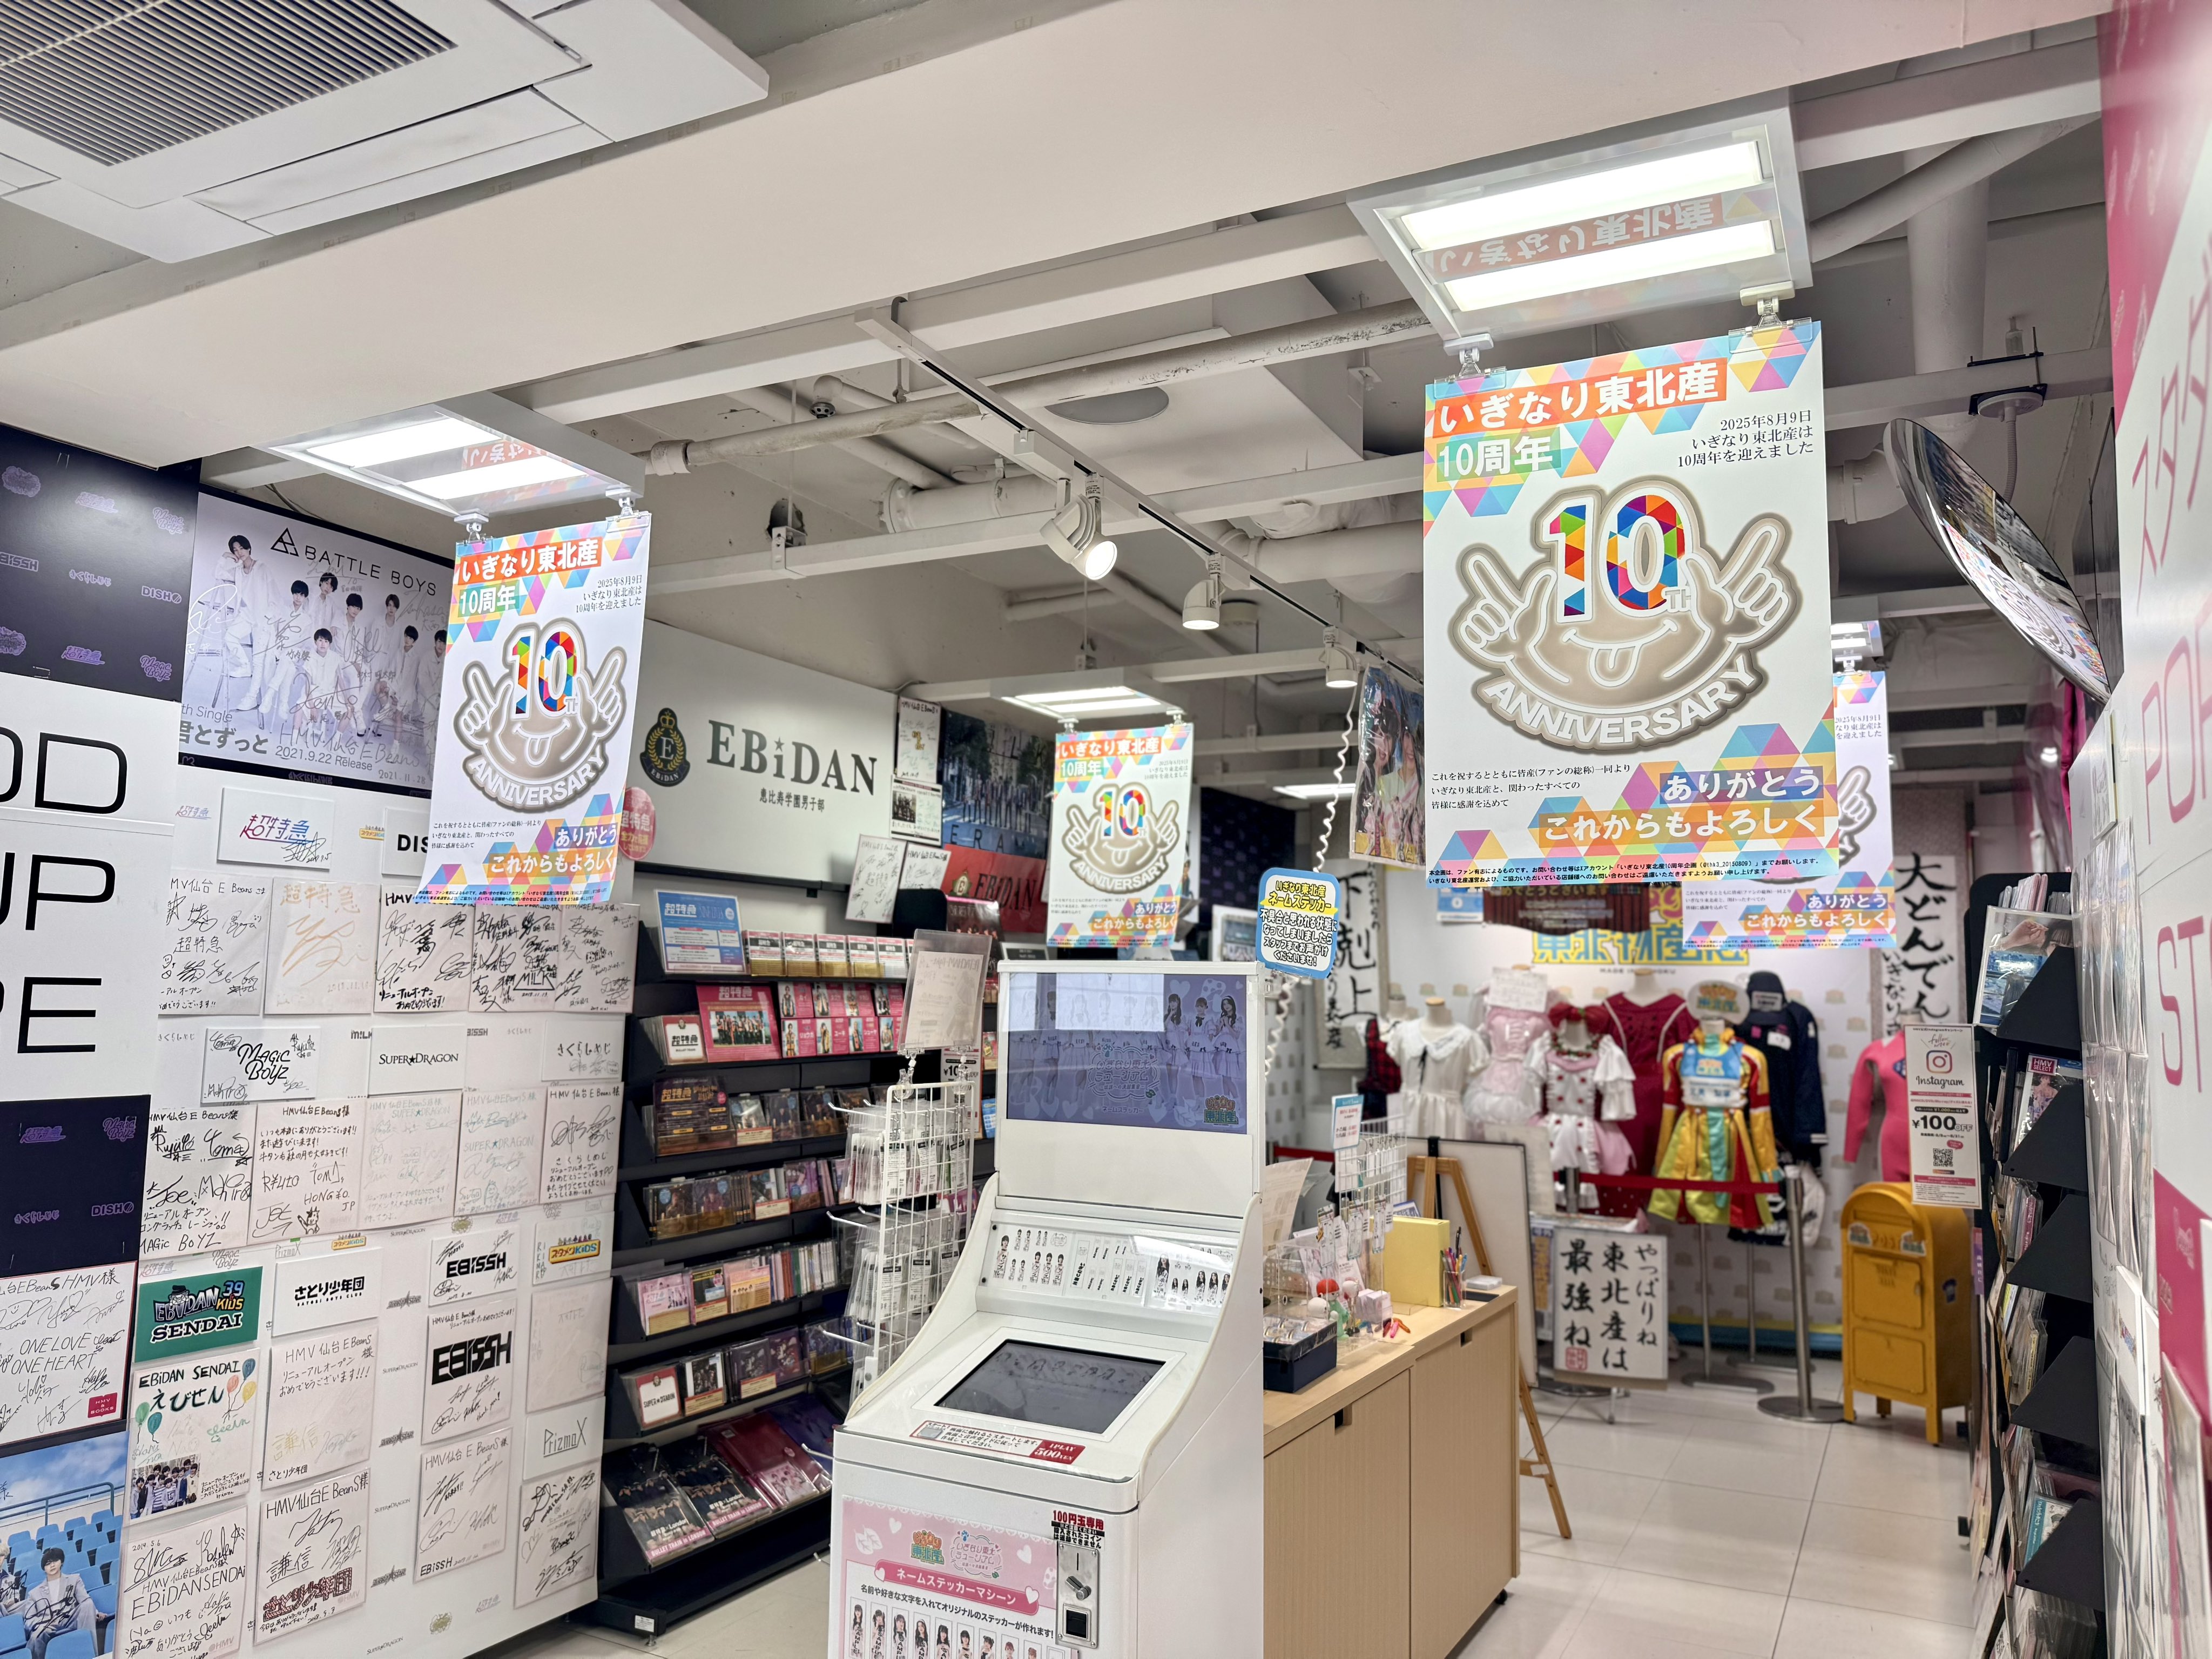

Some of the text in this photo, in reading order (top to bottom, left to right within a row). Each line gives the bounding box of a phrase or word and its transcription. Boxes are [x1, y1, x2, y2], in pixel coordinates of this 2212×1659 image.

[1440, 362, 1718, 433] いぎなり東北産
[1720, 409, 1812, 431] 2025年8月9日
[1692, 425, 1813, 450] いぎなり東北産は
[1439, 436, 1553, 478] 10周年
[1677, 441, 1814, 468] 10周年を迎えました
[305, 545, 436, 596] BATTLE BOYS
[462, 538, 598, 582] いぎなり東北産
[598, 575, 642, 588] 2025年8月9日
[460, 586, 516, 615] 10周年
[583, 586, 642, 600] いぎなり東北産は
[576, 597, 642, 613] 10周年を迎えました
[1485, 655, 1754, 744] ANNIVERSARY
[196, 705, 233, 724] Single
[179, 720, 268, 755] 君とずっと
[1062, 738, 1159, 757] いぎなり東北産
[275, 746, 373, 771] 2021.9.22 Release
[706, 719, 878, 795] EBiDAN
[470, 746, 604, 806] ANNIVERSARY
[1062, 761, 1102, 776] 10周年
[1432, 781, 1580, 795] いぎなり東北産と、関わったすべての
[1664, 769, 1820, 801] ありがとう
[760, 787, 825, 812] 恵比寿学園男子部
[1432, 799, 1509, 810] 皆様に感謝を込めて
[176, 805, 211, 819] 超特急
[1546, 804, 1816, 840] これからもよろしく
[240, 814, 313, 843] 超特急
[556, 826, 617, 847] ありがとう
[491, 852, 616, 874] これからもよろしく
[1077, 855, 1166, 891] ANNIVERSARY
[1276, 881, 1326, 897] いぎなり東北産
[664, 902, 697, 918] 超特急
[1136, 903, 1176, 914] ありがとう
[1269, 891, 1331, 912] ネームステッカー
[1809, 895, 1886, 909] ありがとう
[1094, 918, 1175, 929] これからもよろしく
[1260, 908, 1338, 932] 不具合と思われる状態に
[1748, 913, 1885, 928] これからもよろしく
[173, 936, 223, 954] 超特急
[1263, 923, 1333, 945] なってしまいましたら
[1894, 852, 1957, 1018] 大どんでん
[1264, 936, 1328, 957] スタッフまでお声がけ
[1273, 950, 1317, 967] くださいませ!
[718, 986, 752, 1000] 超特急
[558, 1042, 610, 1057] さくらしめじ
[672, 1034, 698, 1047] 超特急
[1916, 1076, 1964, 1089] Instagram
[661, 1087, 692, 1102] 超特急
[1102, 1106, 1143, 1114] ネームステッカー
[1204, 1110, 1238, 1124] 東北産
[1912, 1115, 1973, 1132] ¥100 OFF
[295, 1277, 365, 1300] さとり少年団
[1561, 1238, 1594, 1348] 最強ね
[1601, 1242, 1629, 1371] 東北産は
[151, 1313, 242, 1343] SENDAI
[20, 1332, 92, 1355] ONE LOVE
[11, 1352, 97, 1375] ONE HEART
[139, 1361, 241, 1388] EBiDAN SENDAI
[284, 1357, 354, 1384] リニューアルオープン
[95, 1396, 111, 1404] HMV
[151, 1386, 224, 1412] えびせん
[91, 1407, 113, 1415] BOOKS
[543, 1417, 588, 1458] PrizmaX
[269, 1464, 307, 1481] さとり少年団
[712, 1516, 727, 1526] BULLET
[728, 1510, 741, 1520] TRAIN
[1053, 1510, 1104, 1530] 100円玉専用
[651, 1531, 706, 1556] BULLET TRAIN LONDON
[911, 1544, 944, 1564] 東北産
[263, 1567, 352, 1622] さとり少年団
[896, 1569, 1016, 1604] ネームステッカーマシーン
[168, 1610, 192, 1624] いつも
[860, 1584, 1054, 1639] 名前や好きな文字を入れてオリジナルのステッカーが作れます!
[157, 1629, 192, 1651] ありがとう
